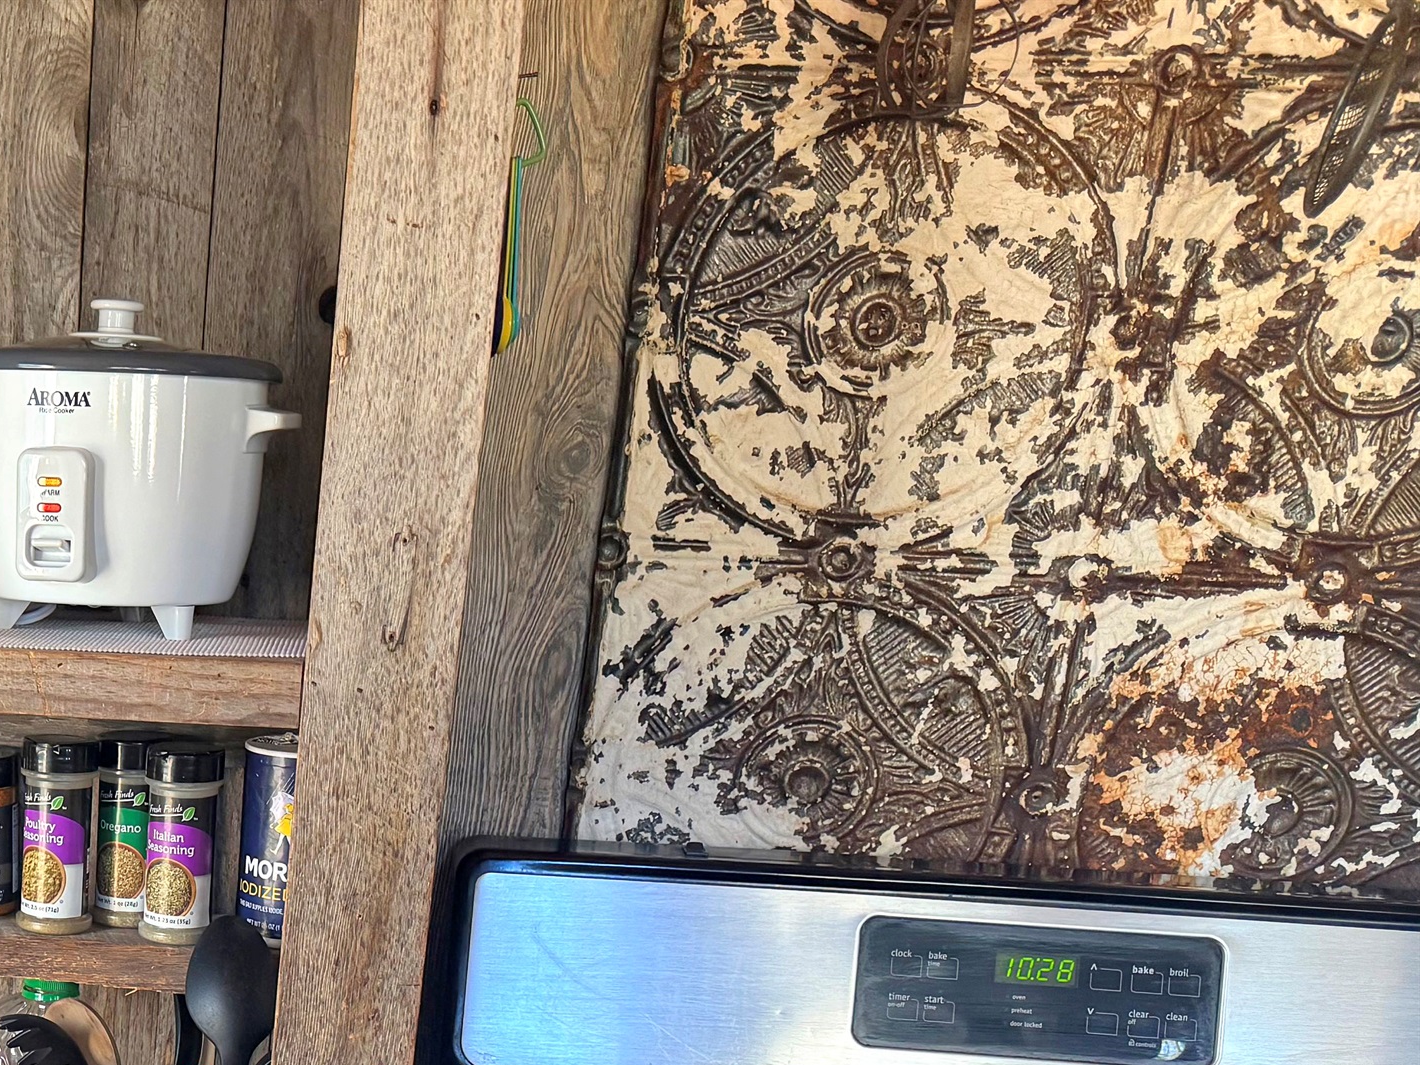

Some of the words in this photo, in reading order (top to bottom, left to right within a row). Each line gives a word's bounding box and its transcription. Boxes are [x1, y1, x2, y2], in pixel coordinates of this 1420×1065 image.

[27, 387, 91, 407] AROMA
[25, 816, 56, 834] Poultry
[100, 819, 142, 835] Oregano
[153, 829, 185, 843] Italian
[147, 838, 195, 858] Seasoning
[890, 948, 913, 958] clock
[928, 951, 948, 960] bake
[1006, 957, 1075, 983] 10:28
[1132, 965, 1155, 975] bake
[1169, 968, 1189, 977] broil
[888, 992, 911, 1001] timer
[924, 995, 945, 1004] start
[1128, 1009, 1150, 1019] clear
[1165, 1012, 1188, 1022] clean
[1023, 1021, 1043, 1029] locked
